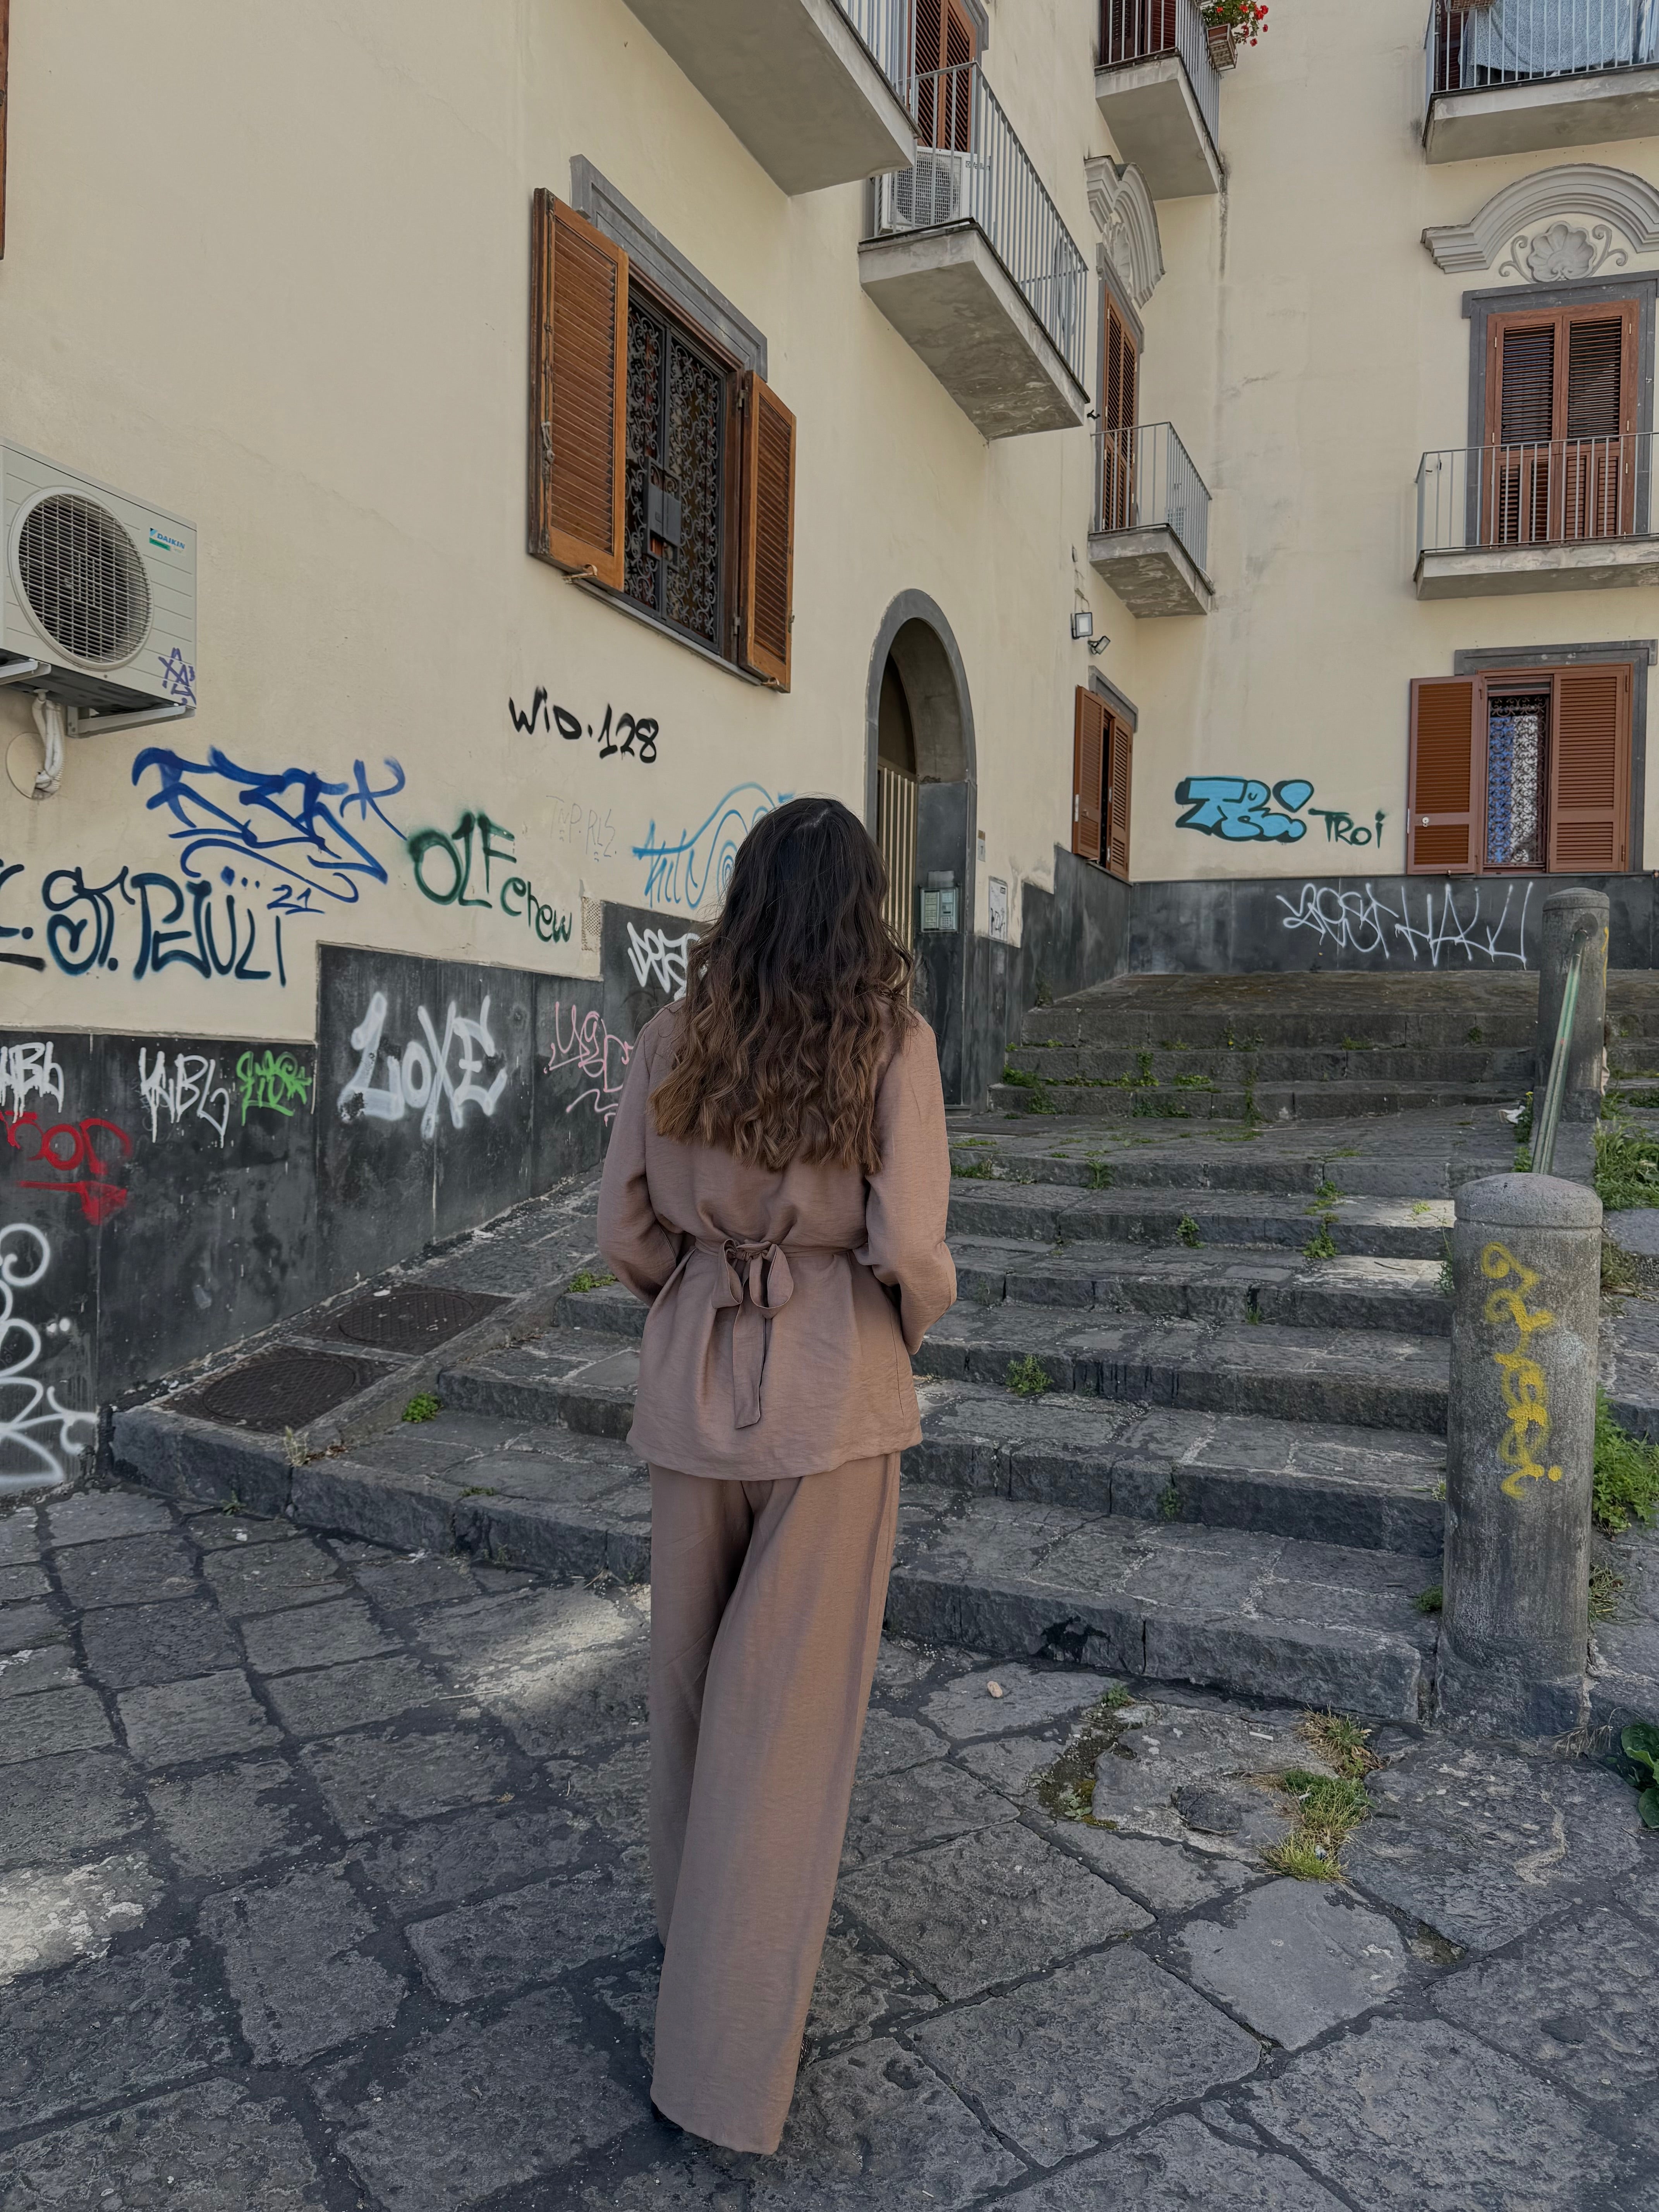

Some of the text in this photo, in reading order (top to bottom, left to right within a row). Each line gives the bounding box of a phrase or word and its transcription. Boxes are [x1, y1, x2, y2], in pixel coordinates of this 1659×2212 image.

[157, 533, 185, 549] DAIKIN
[267, 884, 312, 910] 21
[337, 991, 508, 1139] LOVE
